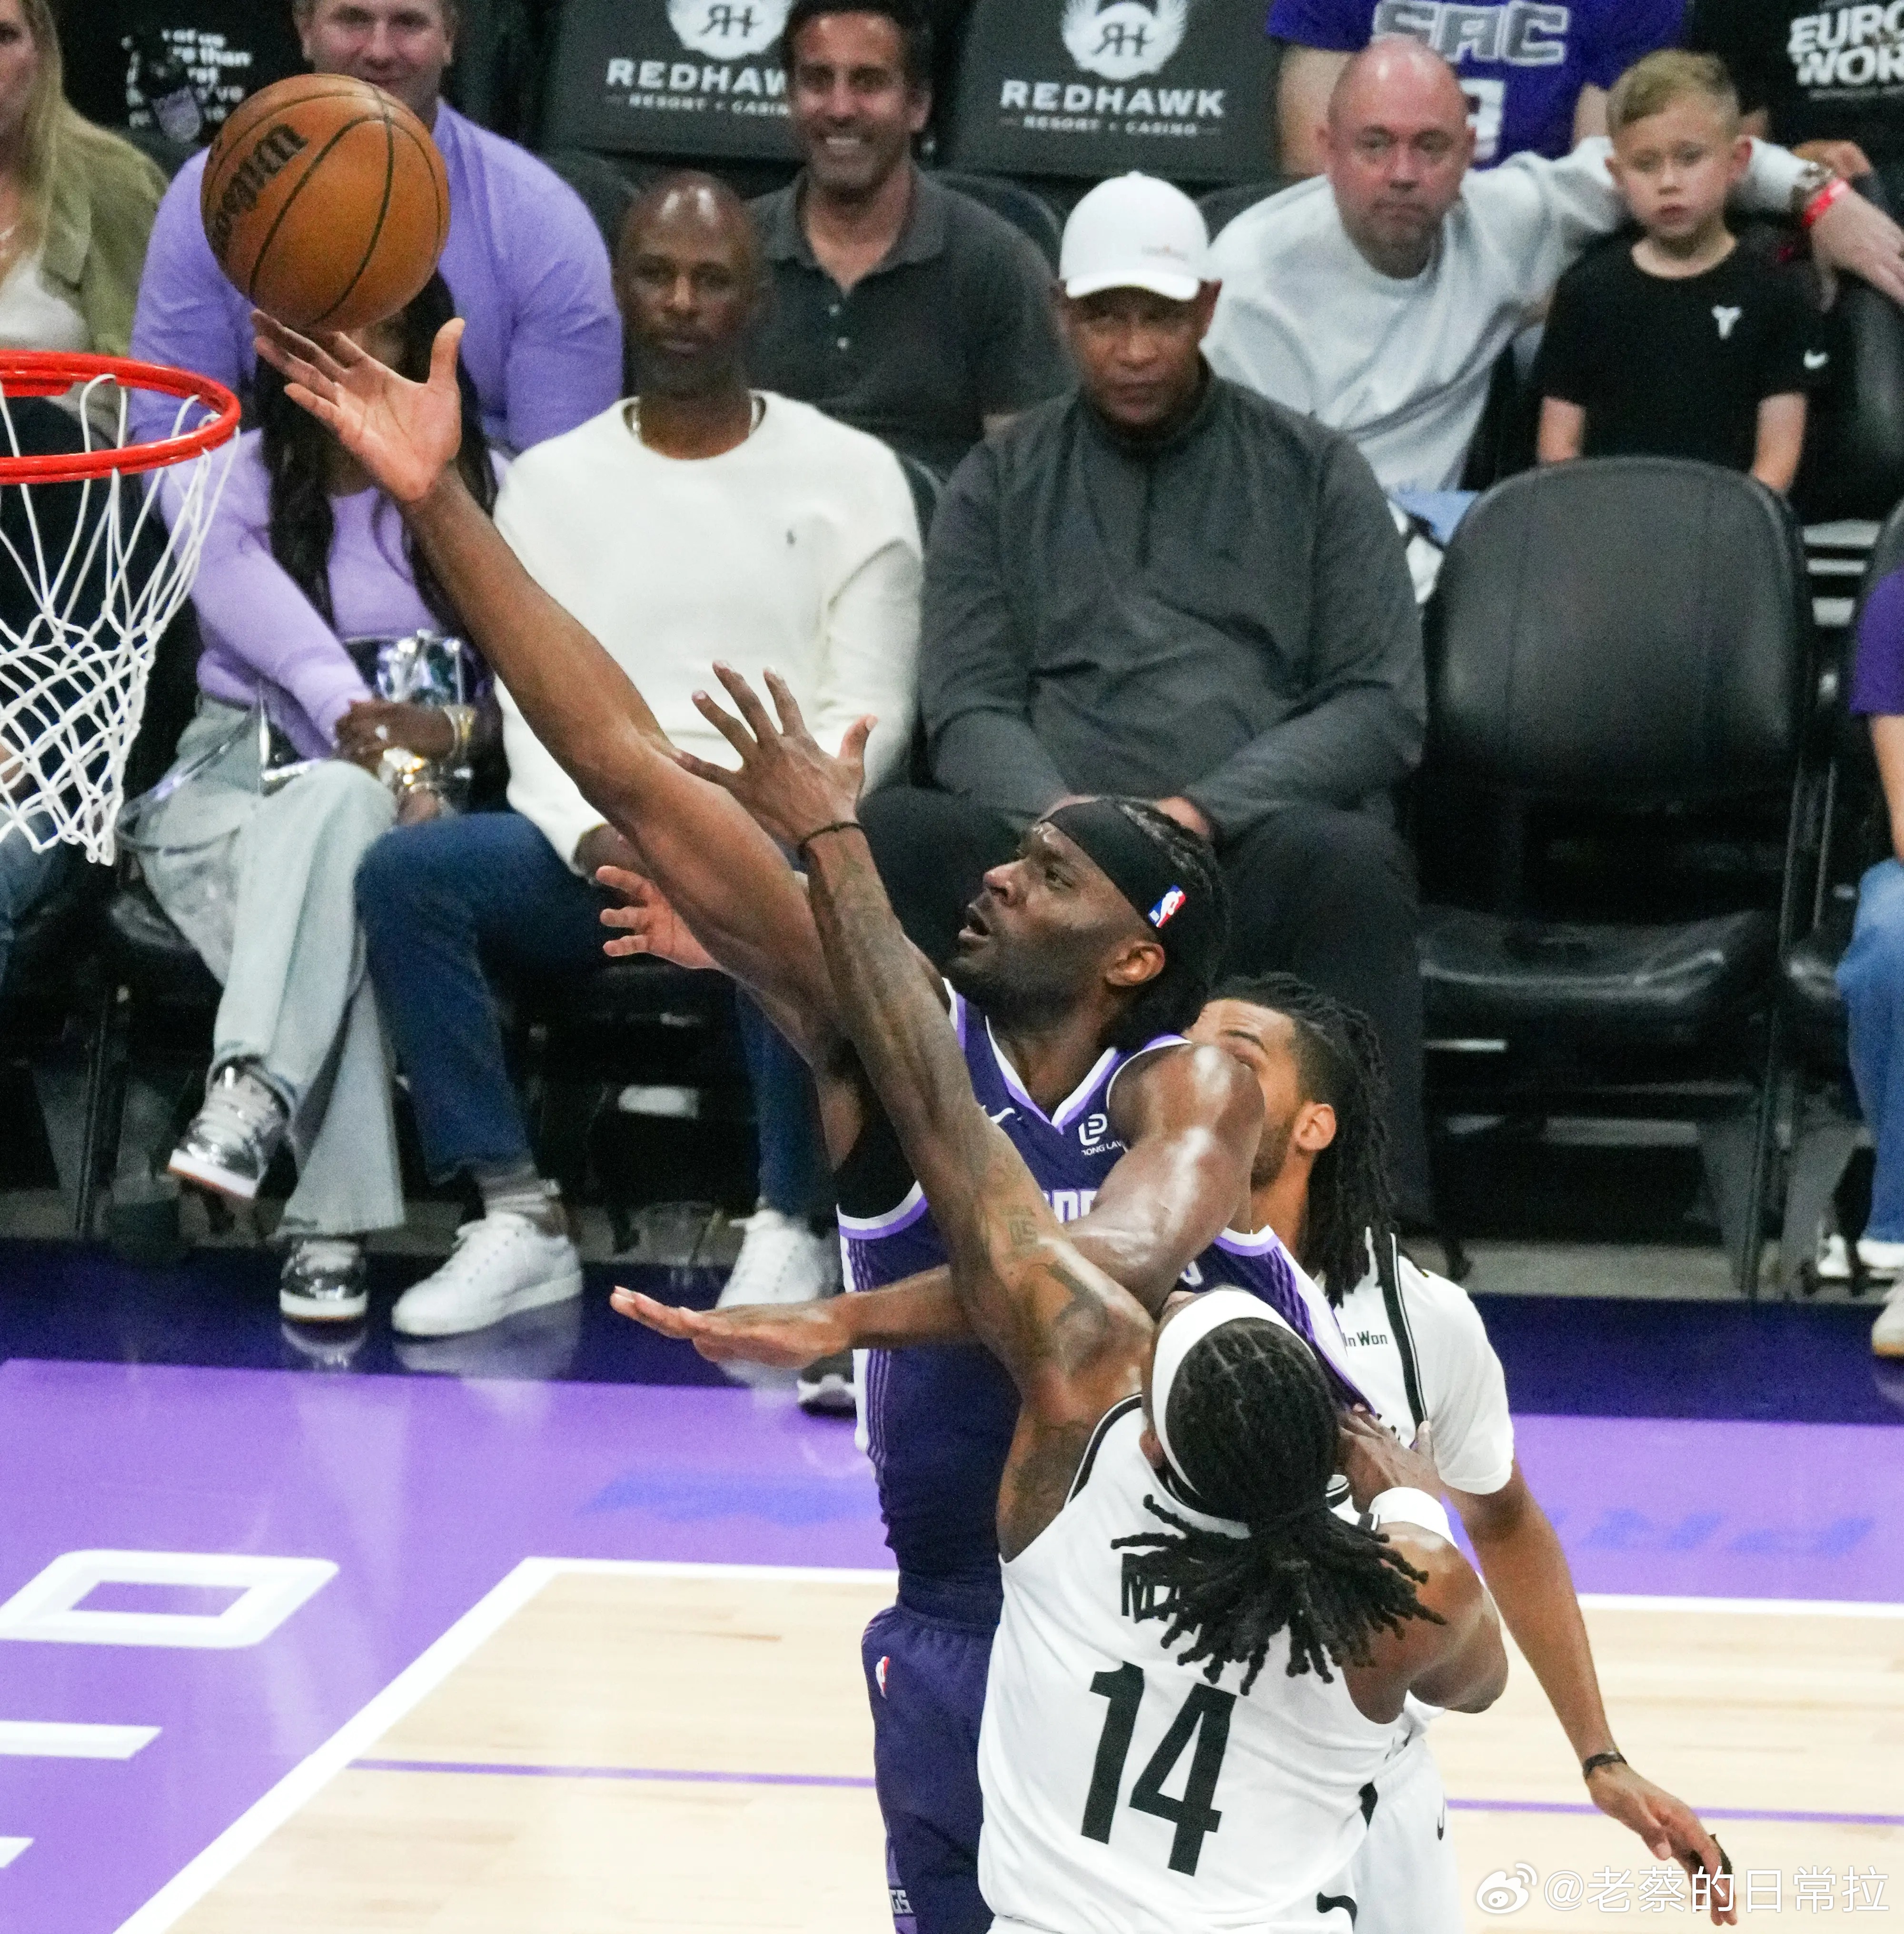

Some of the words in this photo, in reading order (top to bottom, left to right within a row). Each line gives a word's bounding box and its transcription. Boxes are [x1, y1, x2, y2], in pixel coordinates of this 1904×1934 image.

[1372, 0, 1568, 66] SAC
[1000, 80, 1225, 119] REDHAWK
[1081, 1659, 1237, 1877] 14
